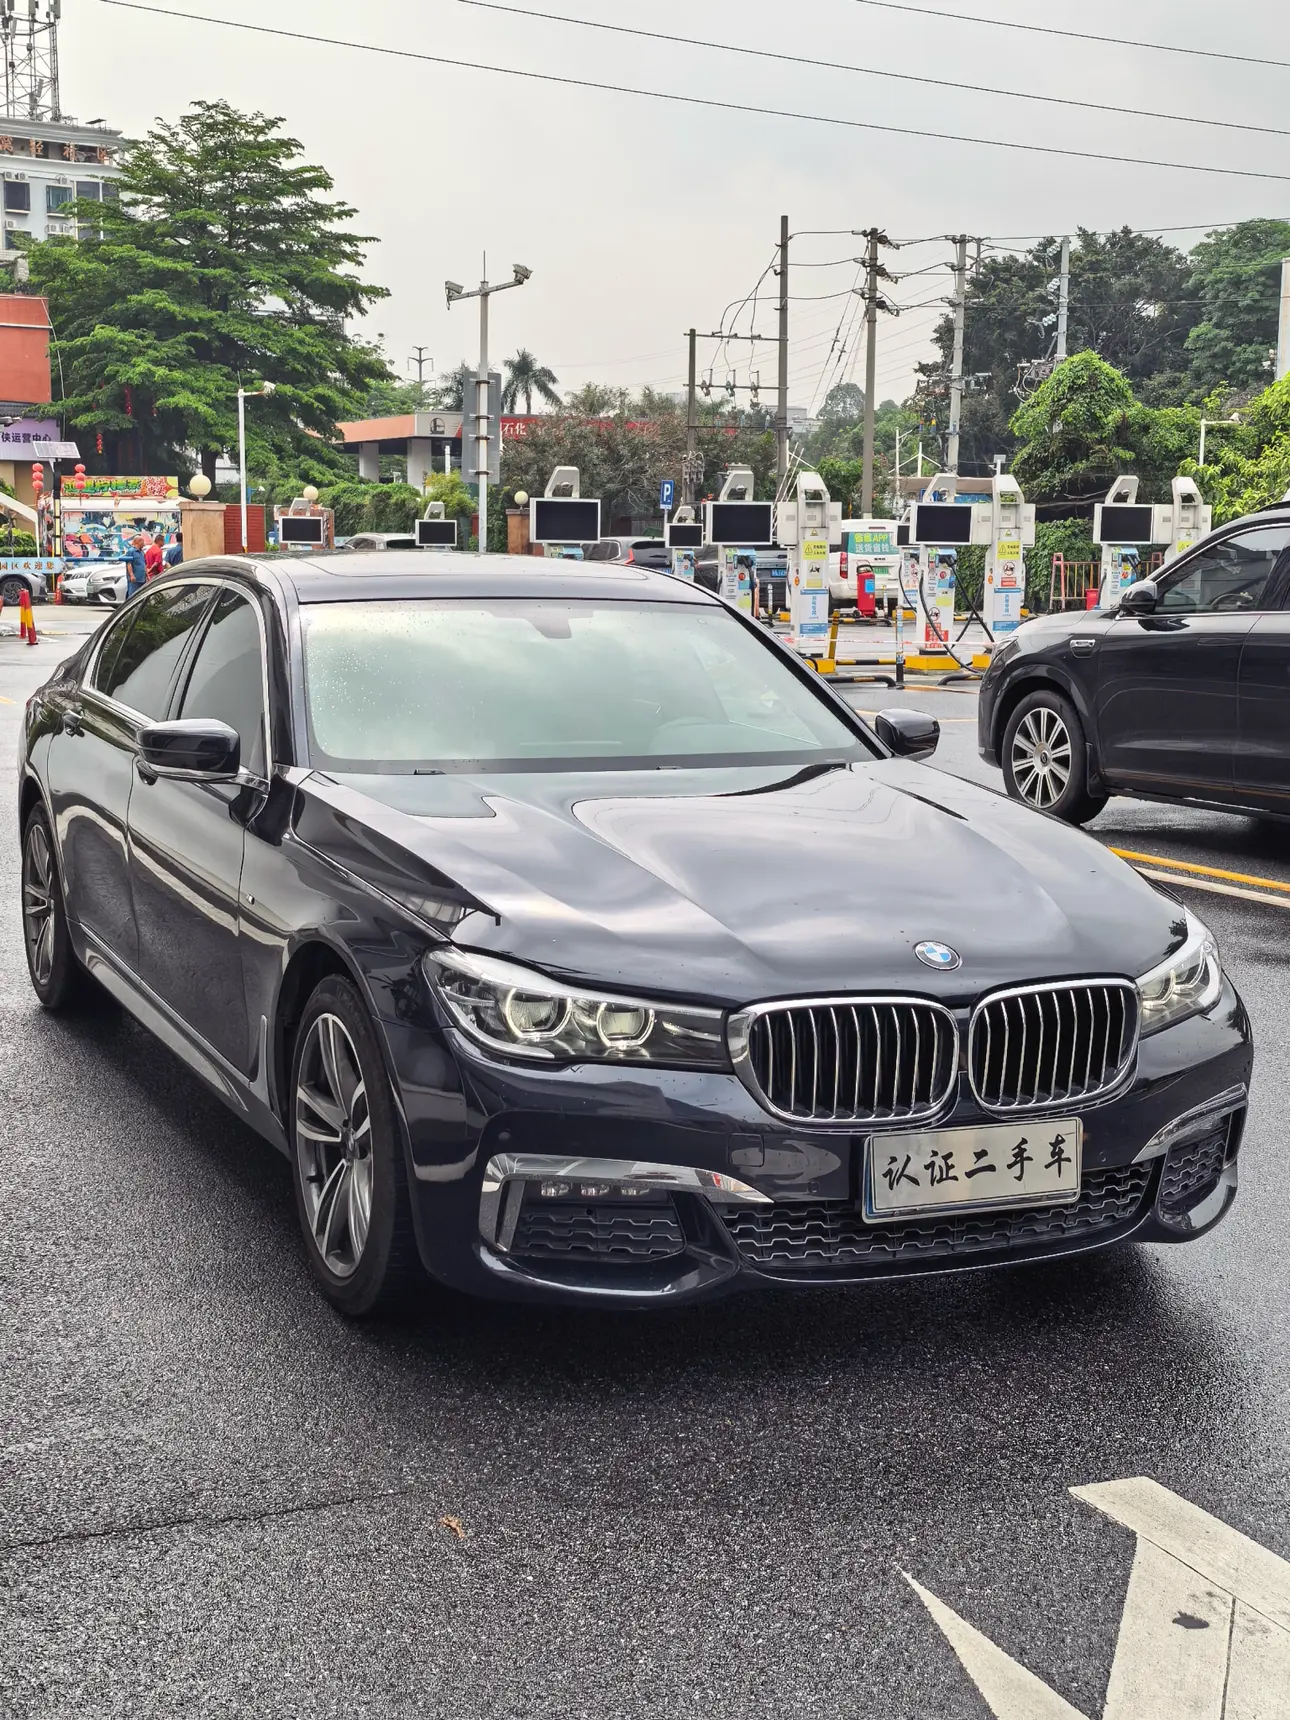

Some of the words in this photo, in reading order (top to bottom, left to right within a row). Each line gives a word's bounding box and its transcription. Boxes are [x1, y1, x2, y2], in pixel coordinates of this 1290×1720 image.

[500, 422, 527, 436] 石化
[663, 483, 671, 502] P
[881, 1132, 1073, 1191] 认证二手车
